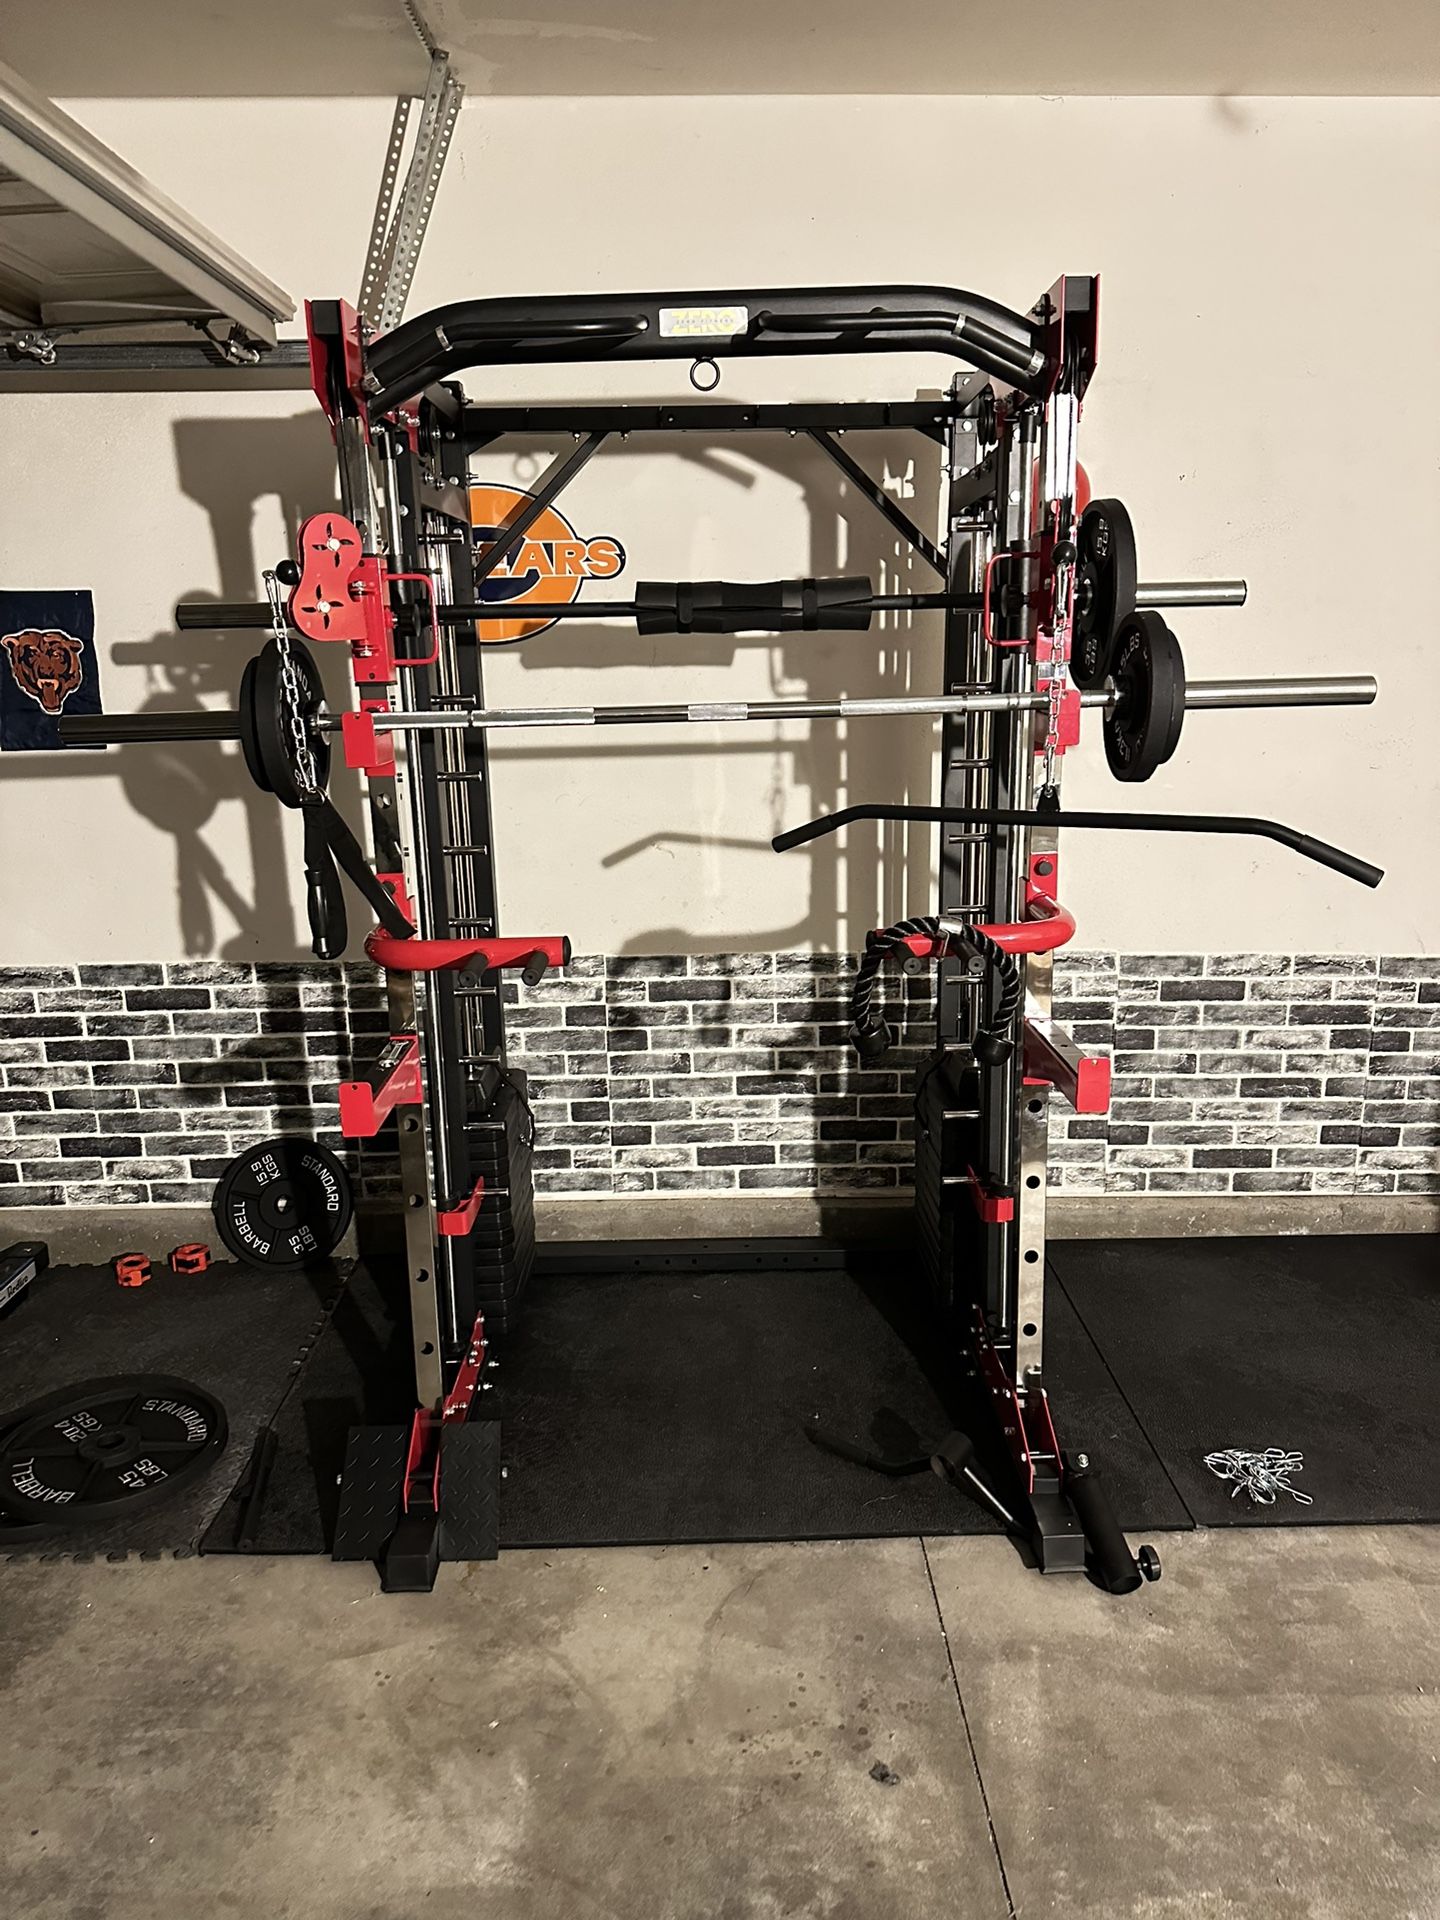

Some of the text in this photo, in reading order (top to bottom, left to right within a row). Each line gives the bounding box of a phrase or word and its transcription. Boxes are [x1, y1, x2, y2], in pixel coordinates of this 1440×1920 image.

[672, 309, 736, 334] ZERO
[250, 1162, 269, 1187] 15.9
[261, 1153, 281, 1180] KGS
[301, 1154, 339, 1212] STANDARD
[232, 1201, 271, 1255] BARBELL
[298, 1225, 318, 1252] LBS
[288, 1235, 305, 1255] 35
[54, 1419, 88, 1443] 20.4
[142, 1399, 208, 1443] STANDARD
[12, 1457, 76, 1505] BARBELL
[118, 1470, 147, 1489] 45
[134, 1458, 169, 1483] LBS
